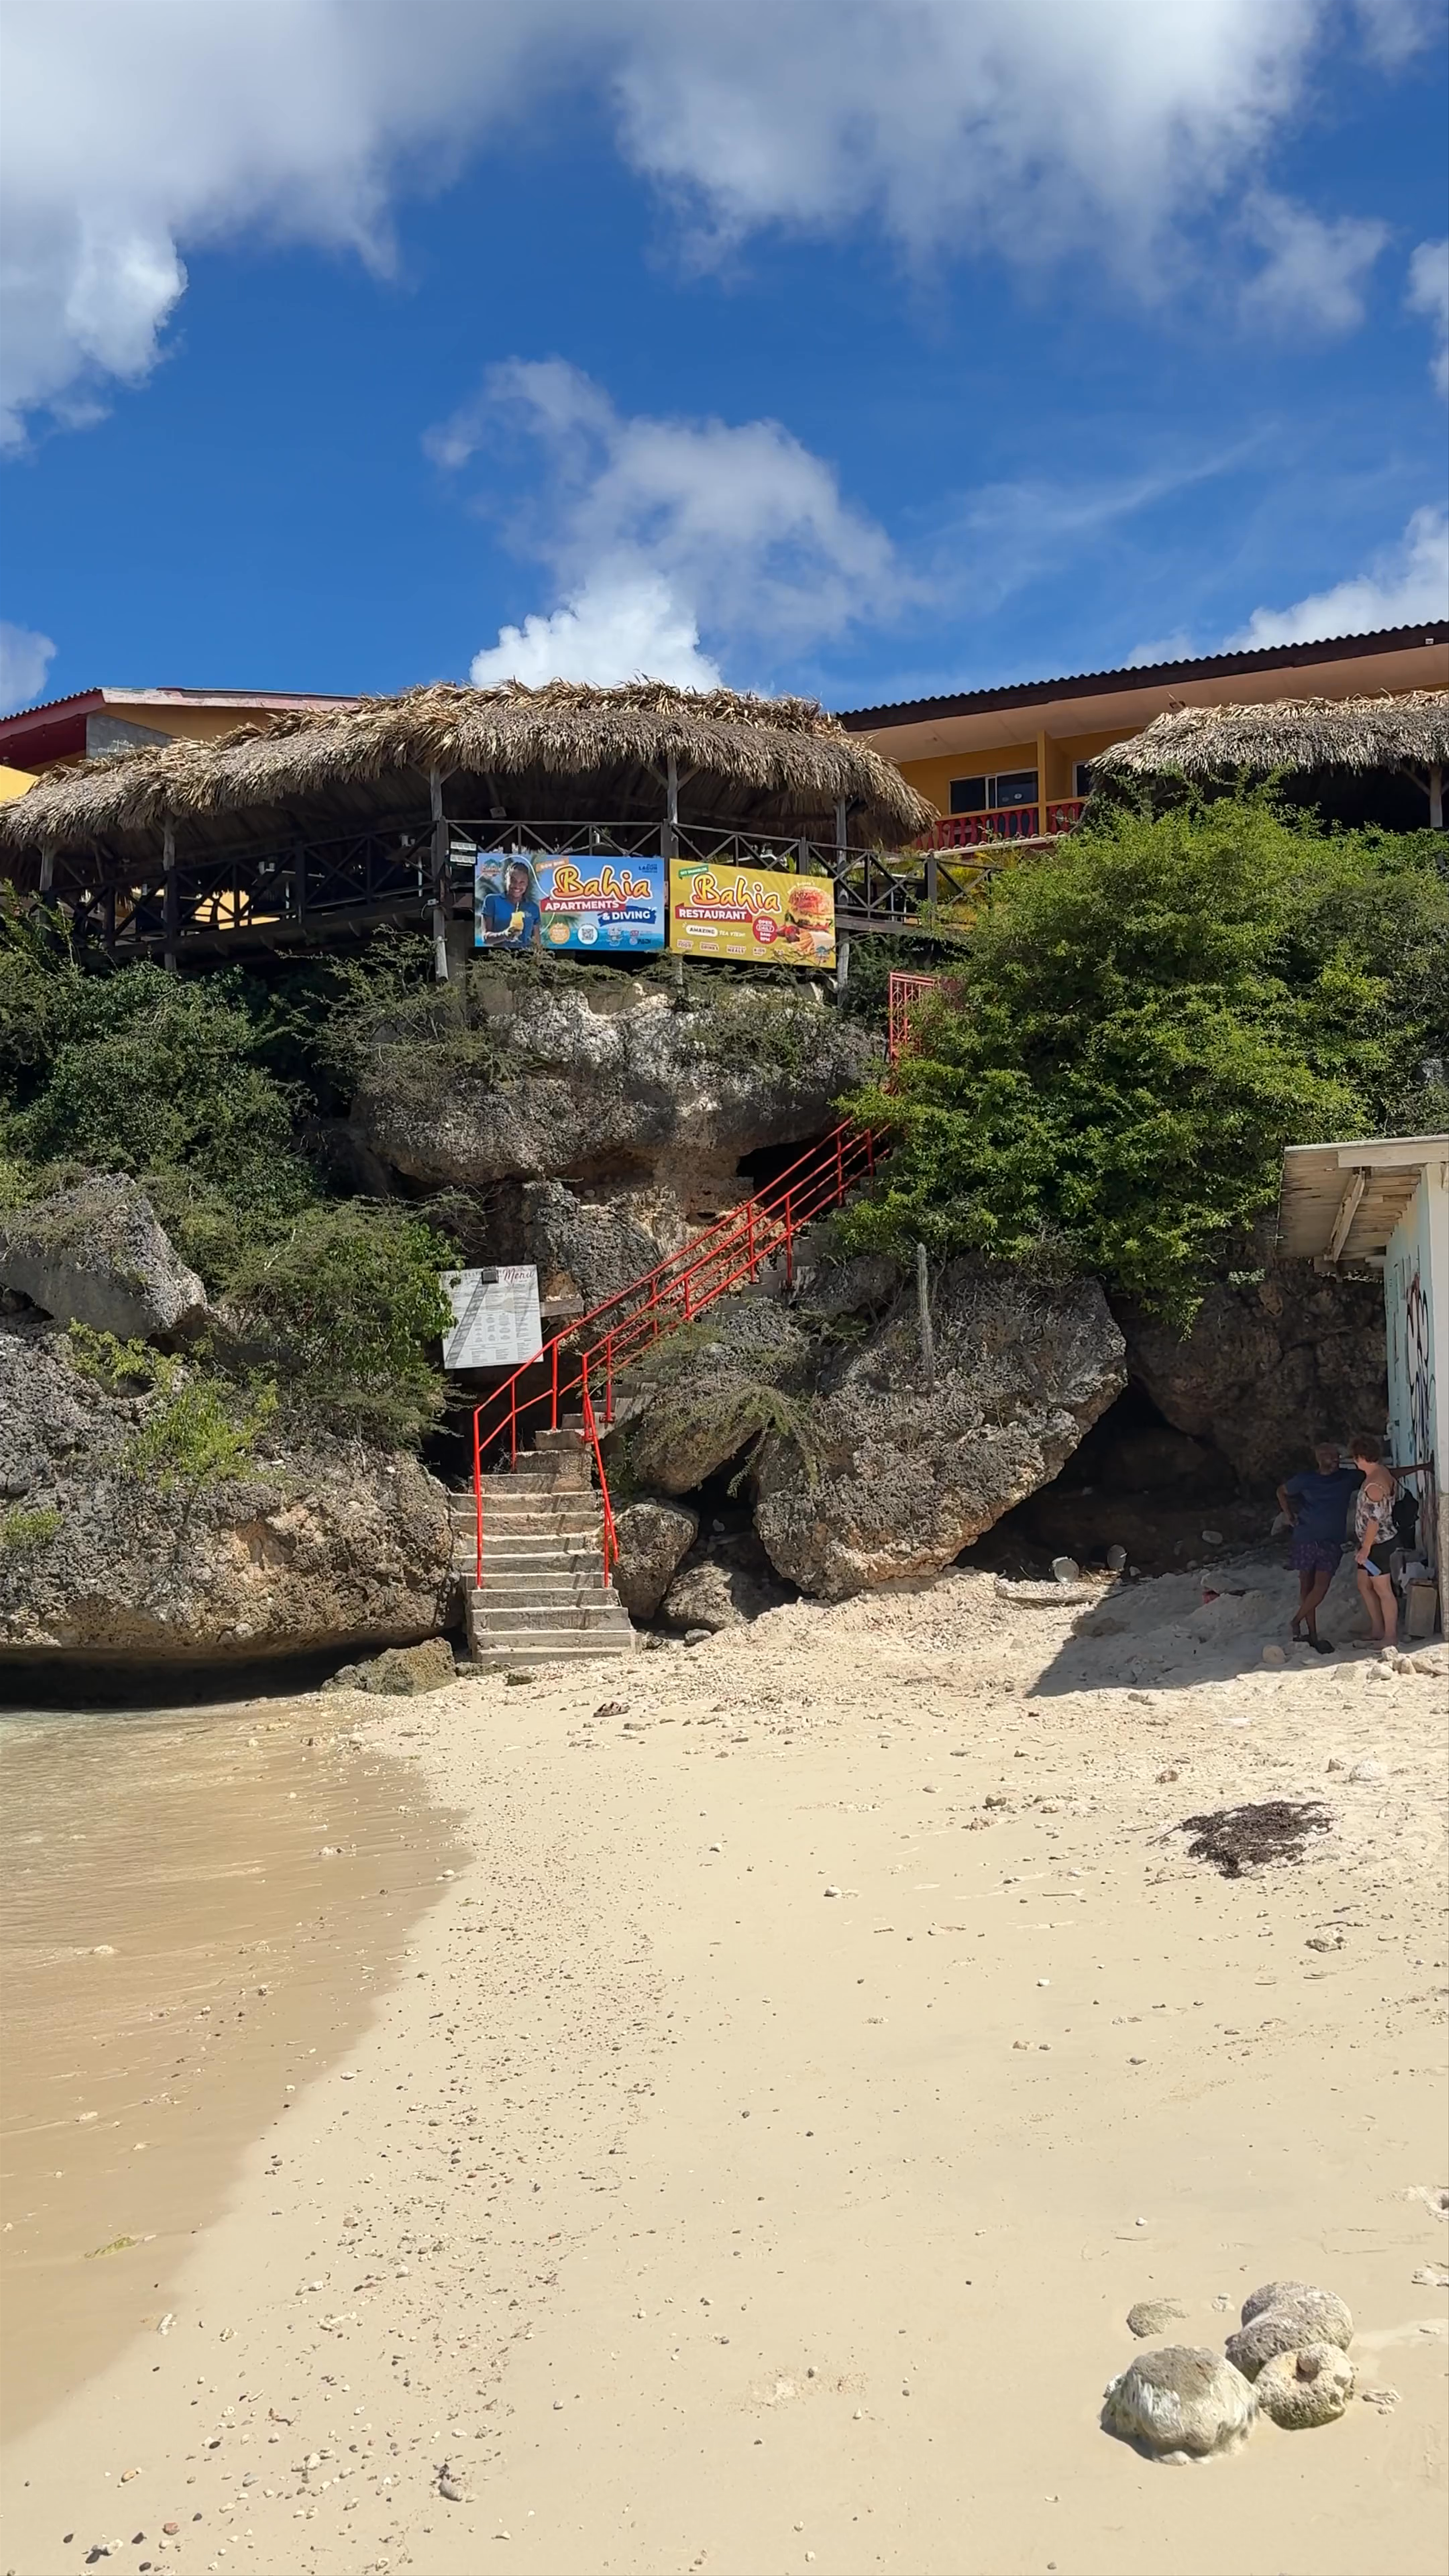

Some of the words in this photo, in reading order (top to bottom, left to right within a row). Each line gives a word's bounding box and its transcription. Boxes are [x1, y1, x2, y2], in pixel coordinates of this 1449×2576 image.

[552, 865, 651, 902] Bahia
[691, 872, 781, 915] Bahia
[545, 900, 620, 910] APARTMENTS
[602, 912, 610, 921] &
[612, 910, 651, 920] DIVING
[679, 909, 747, 920] RESTAURANT
[503, 1268, 534, 1284] Menu
